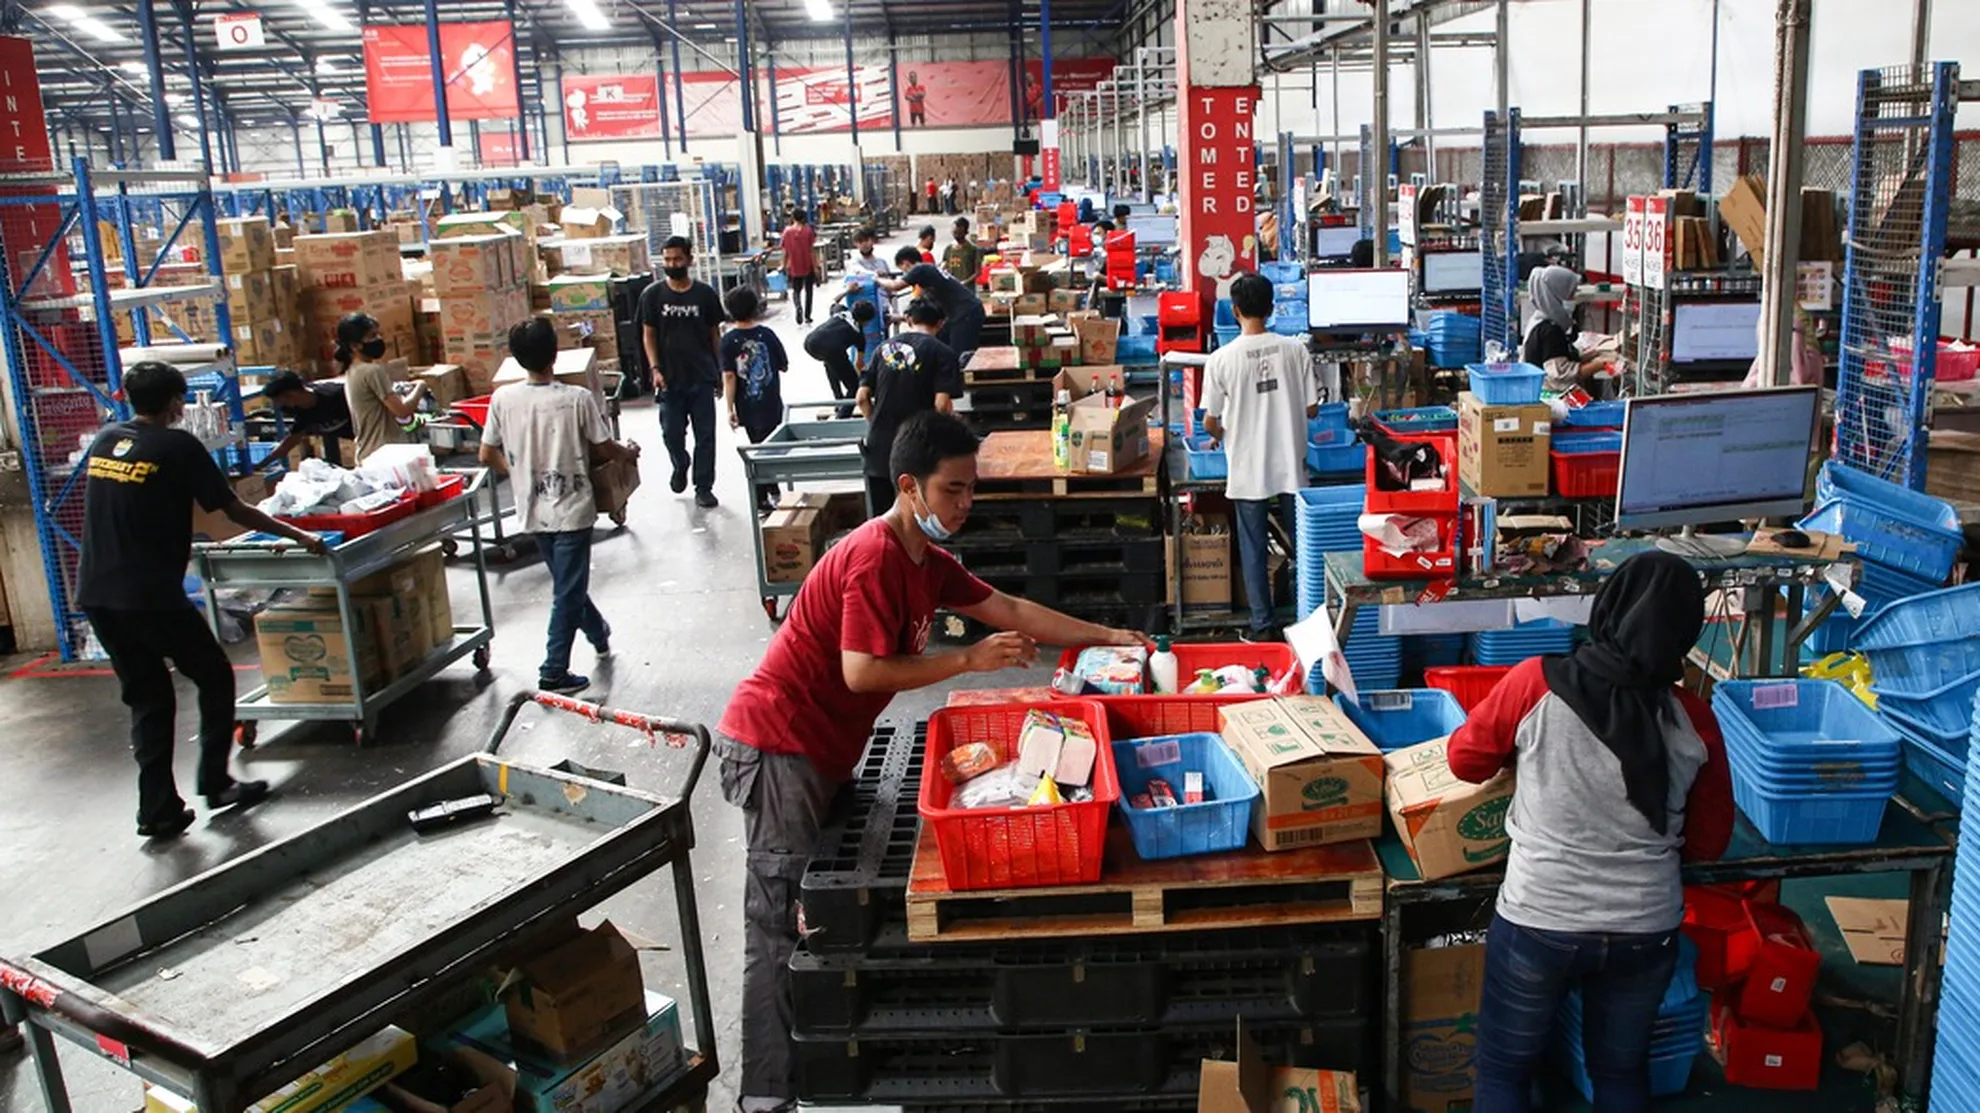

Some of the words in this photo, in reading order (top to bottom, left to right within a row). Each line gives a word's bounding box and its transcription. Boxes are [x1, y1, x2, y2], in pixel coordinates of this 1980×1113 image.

[231, 25, 248, 44] O
[1200, 86, 1217, 213] TOMER
[1625, 219, 1641, 250] 35
[1645, 220, 1662, 253] 36
